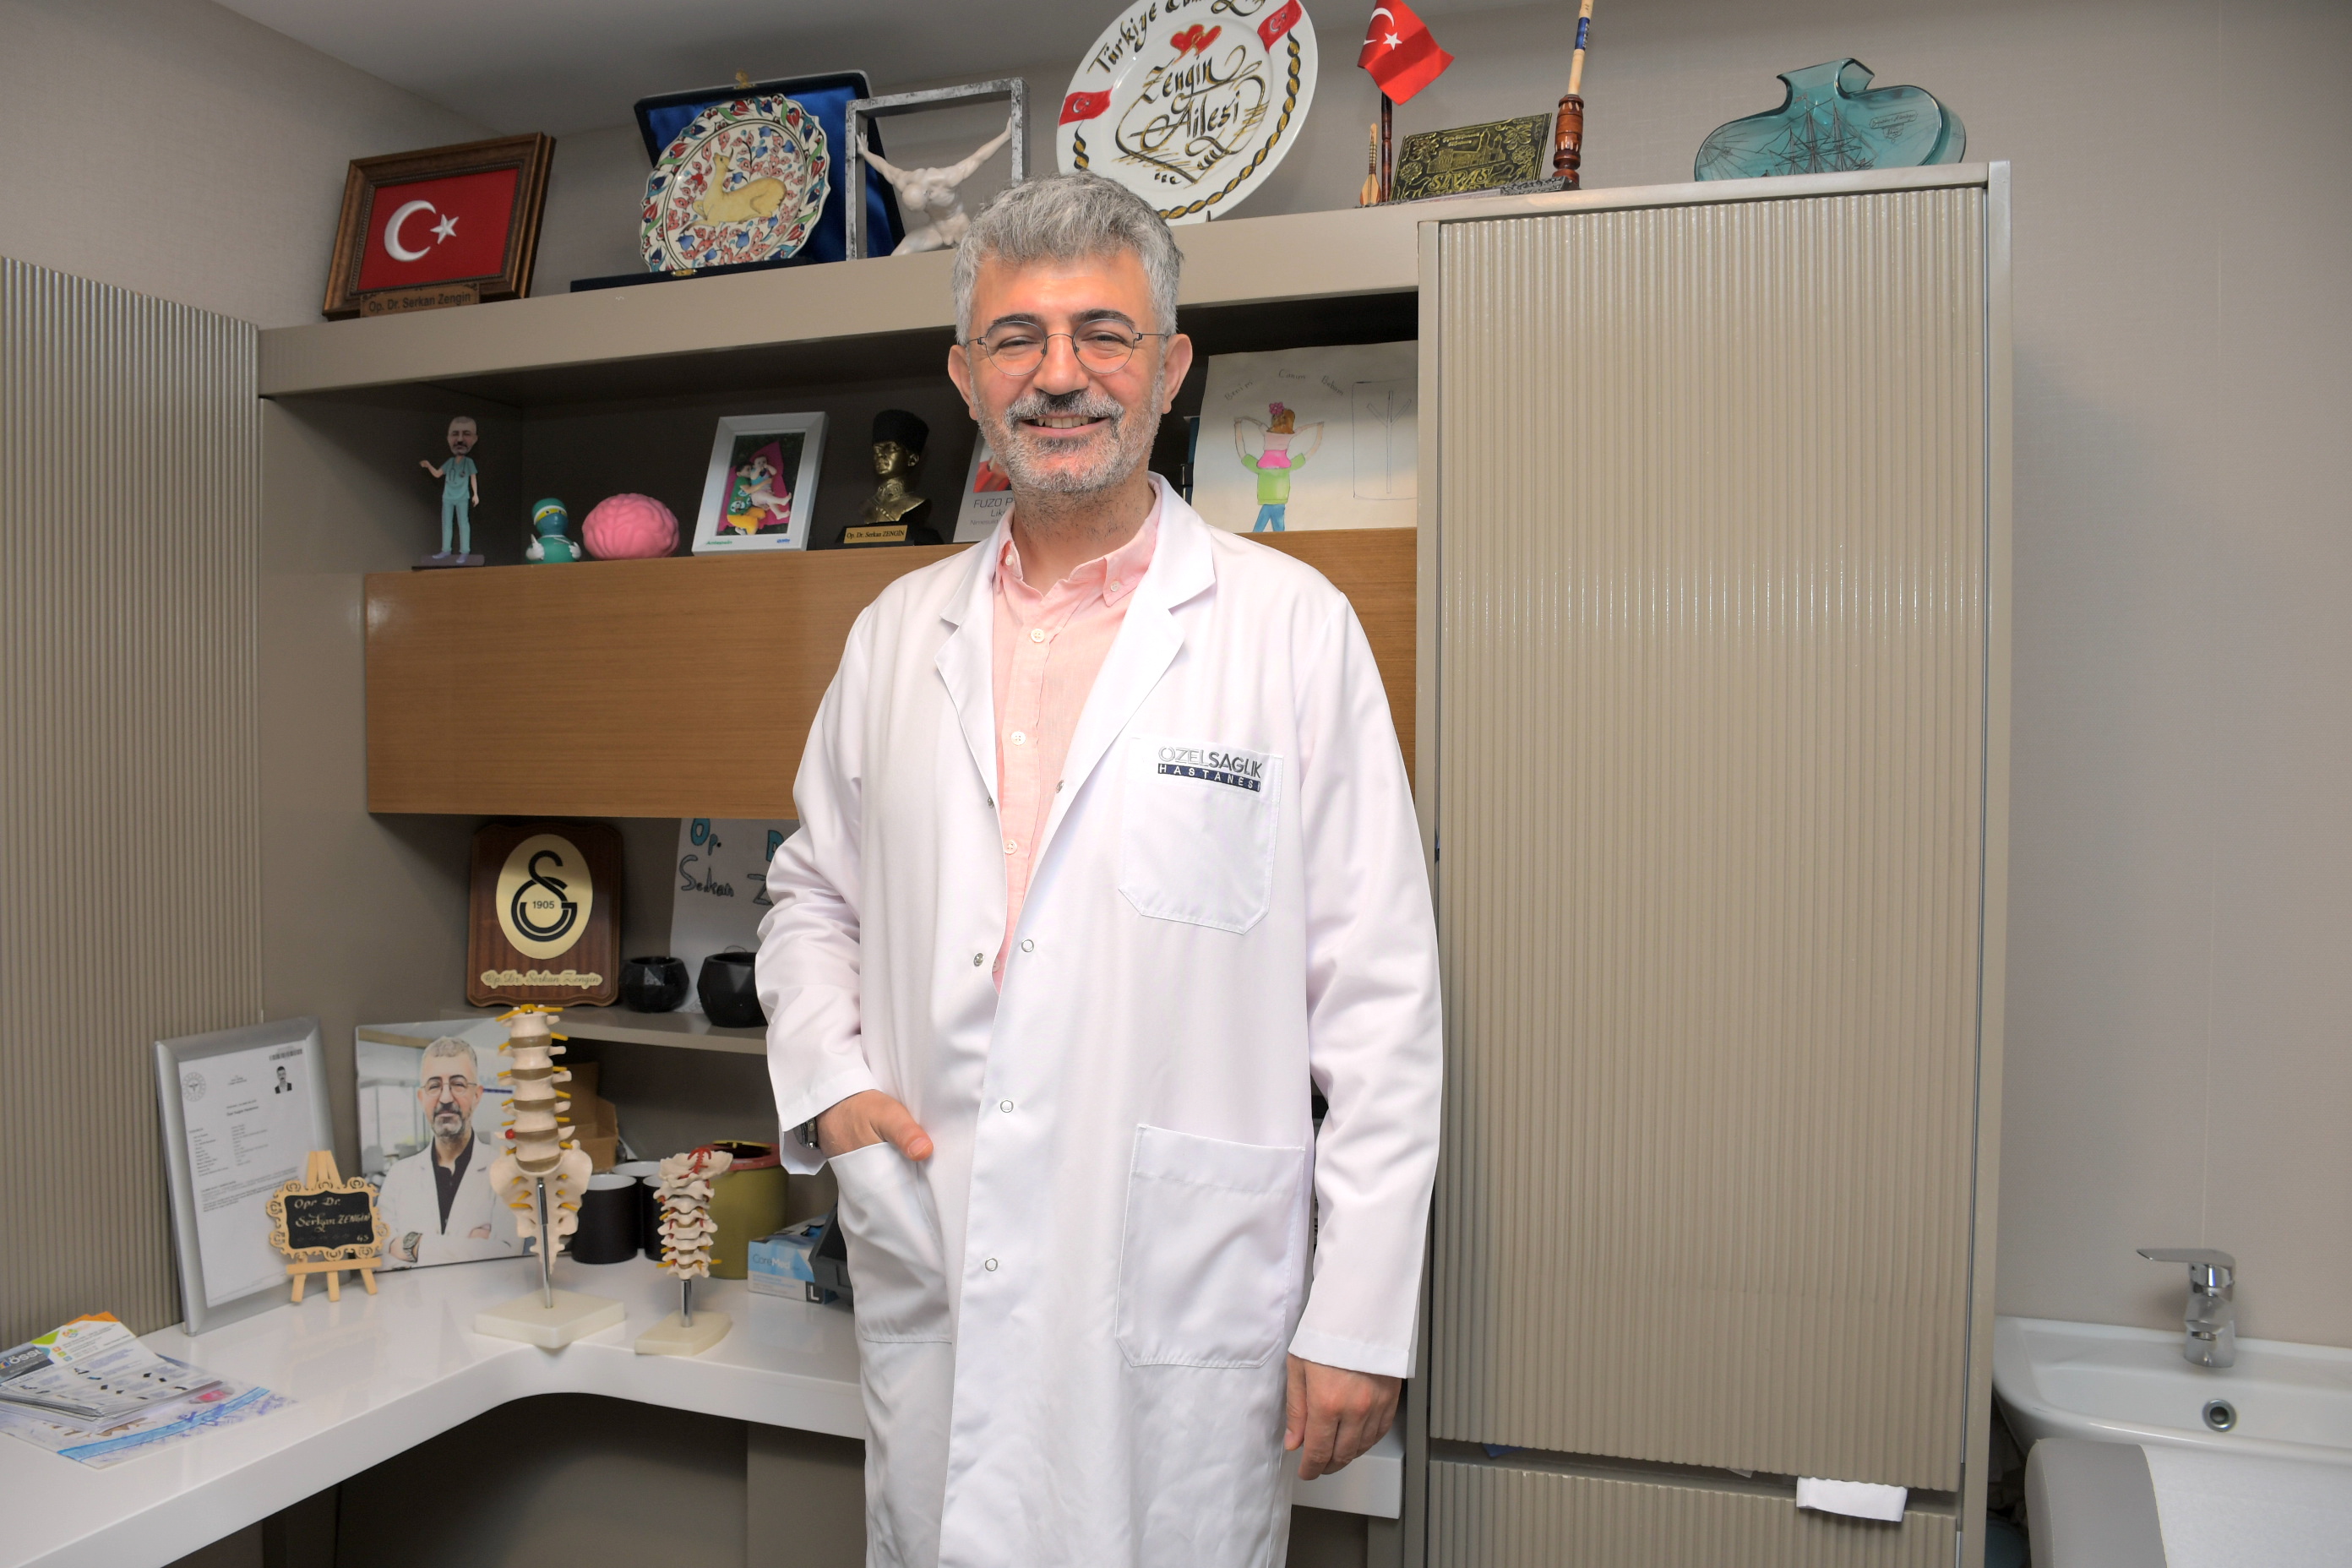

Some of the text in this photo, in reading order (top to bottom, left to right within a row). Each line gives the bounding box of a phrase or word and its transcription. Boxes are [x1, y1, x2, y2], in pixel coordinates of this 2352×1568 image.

[368, 293, 471, 313] Op. Dr. Serkan Zengin
[974, 498, 1003, 508] FUZO
[532, 901, 555, 909] 1905
